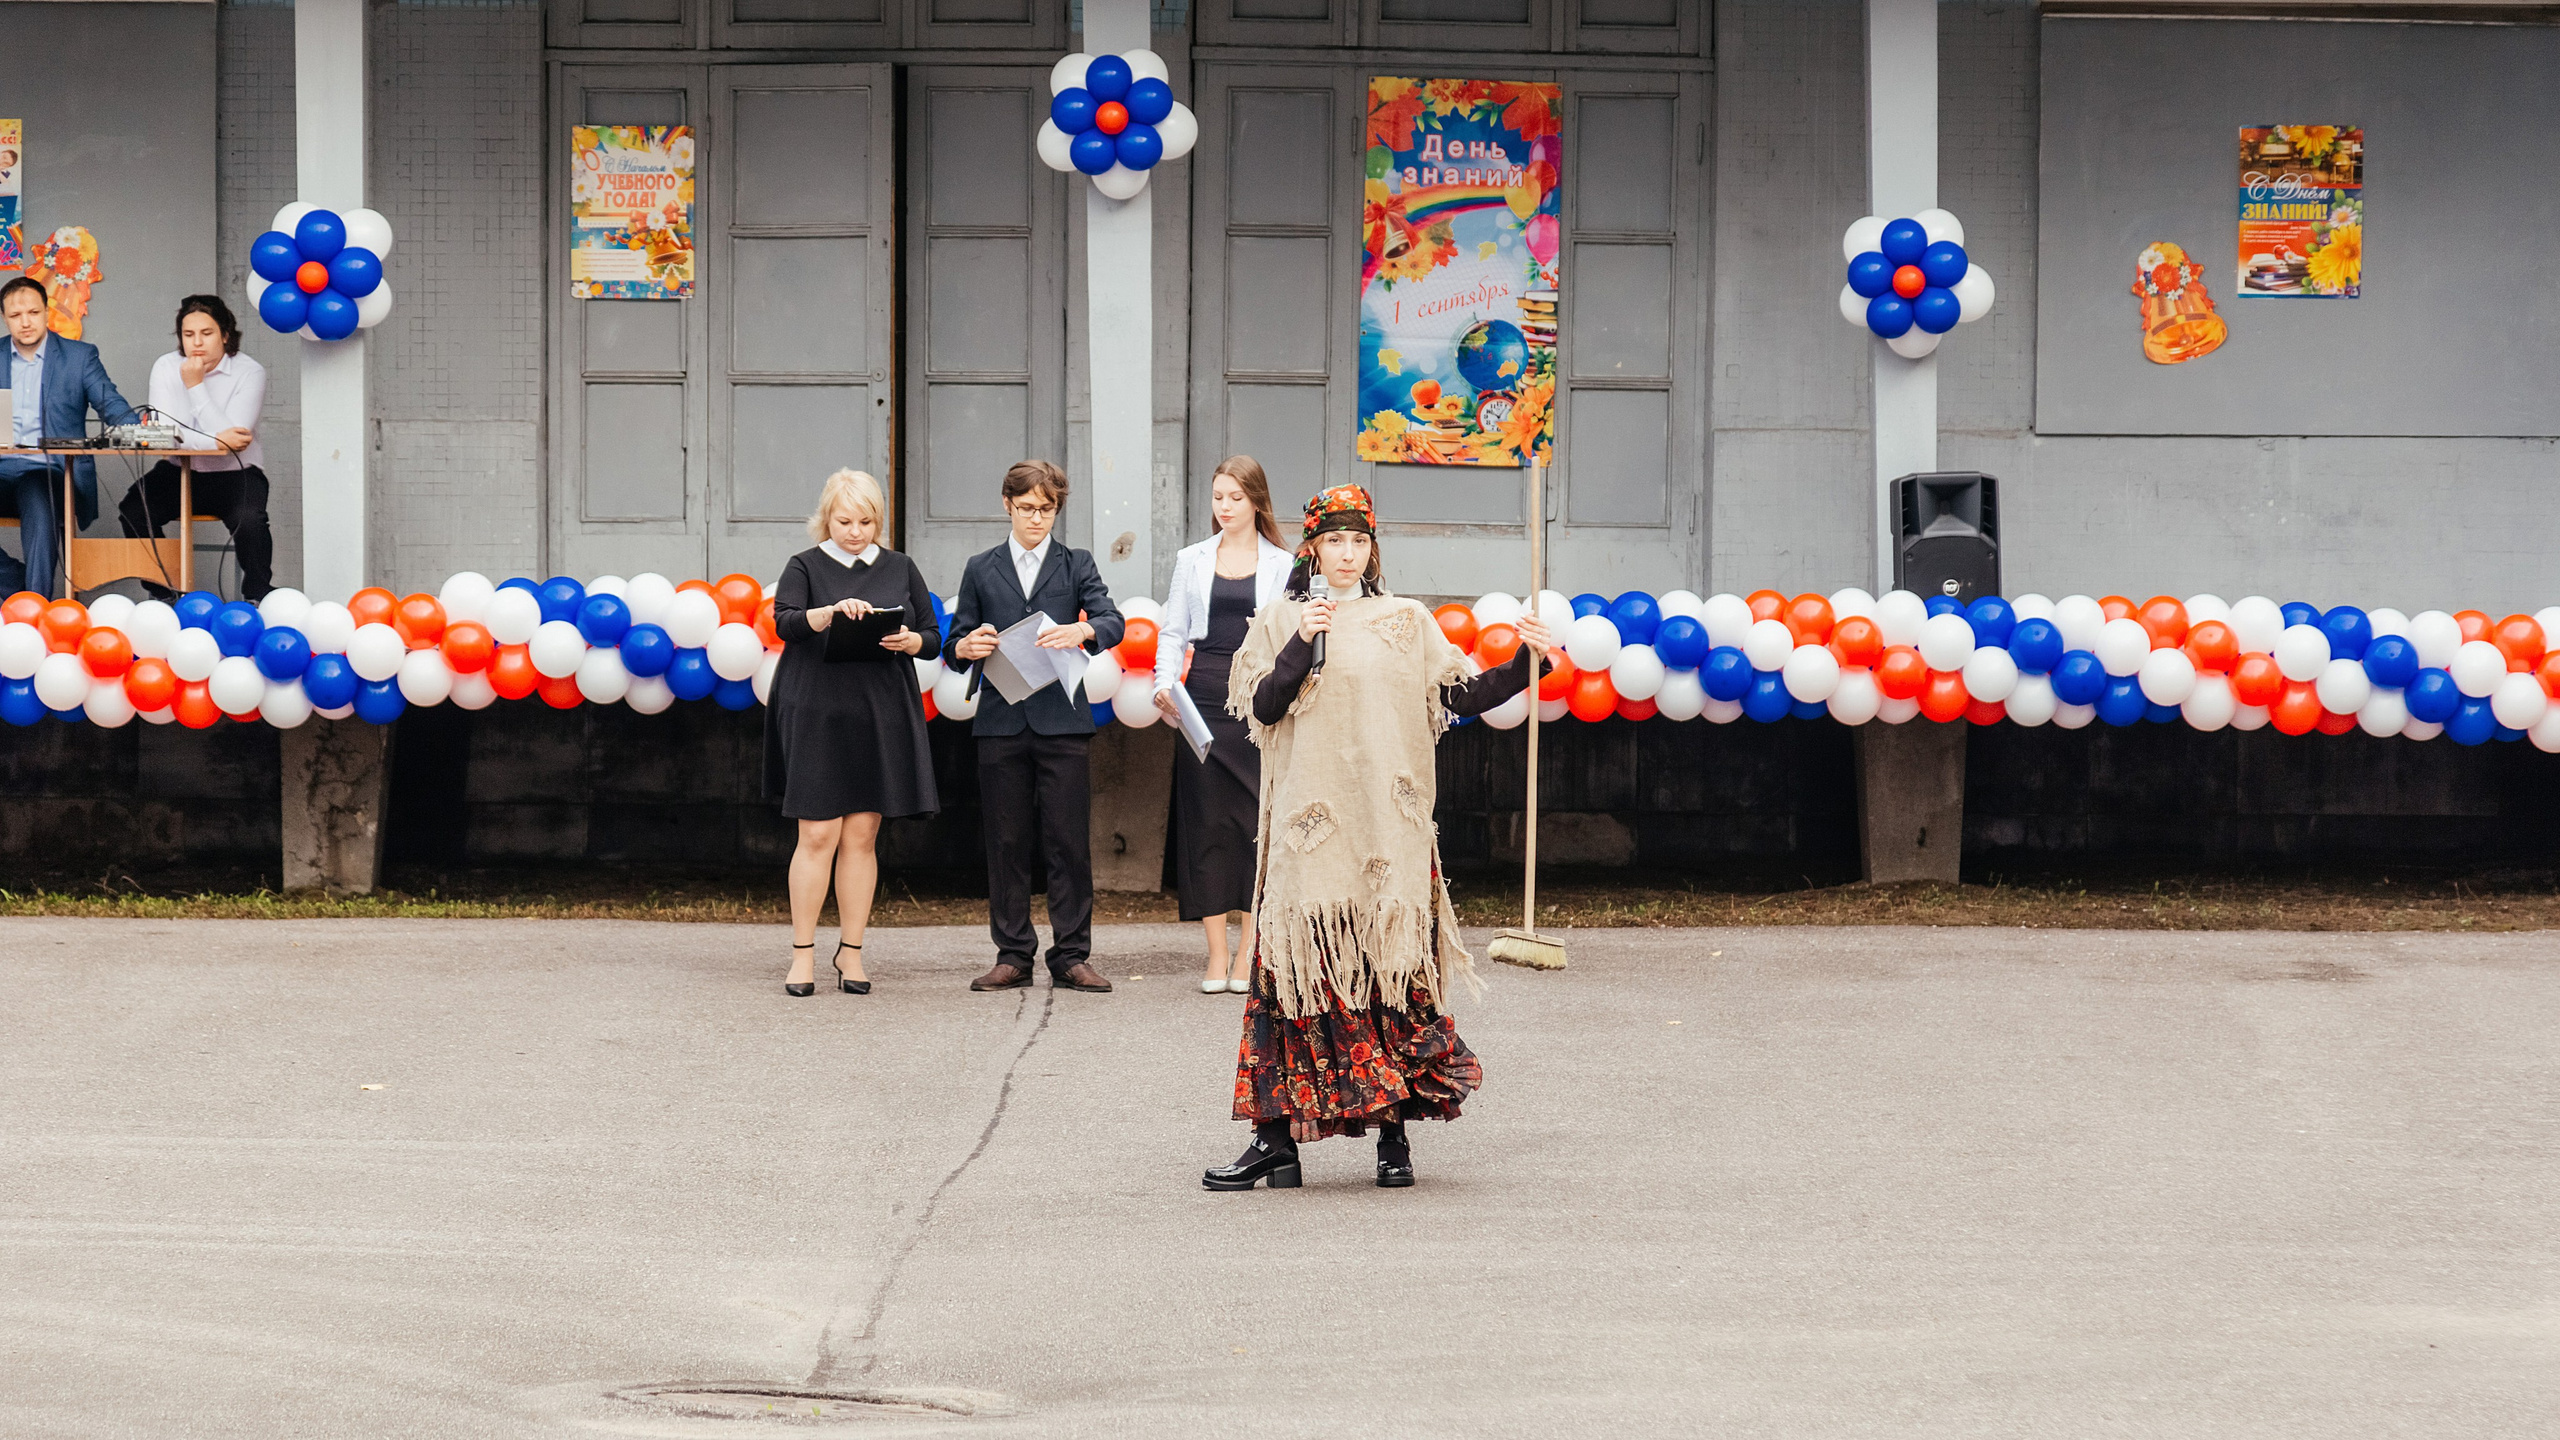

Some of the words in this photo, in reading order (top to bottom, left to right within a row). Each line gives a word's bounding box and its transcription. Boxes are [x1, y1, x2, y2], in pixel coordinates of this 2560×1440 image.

[1422, 134, 1507, 162] День
[602, 155, 615, 173] С
[596, 173, 676, 190] УЧЕБНОГО
[1403, 165, 1524, 188] знаний
[2243, 170, 2270, 201] С
[2271, 172, 2331, 200] Днём
[603, 191, 657, 208] ГОДА!
[2242, 200, 2328, 220] ЗНАНИЙ!
[1393, 300, 1401, 324] 1
[1417, 275, 1512, 319] сентября
